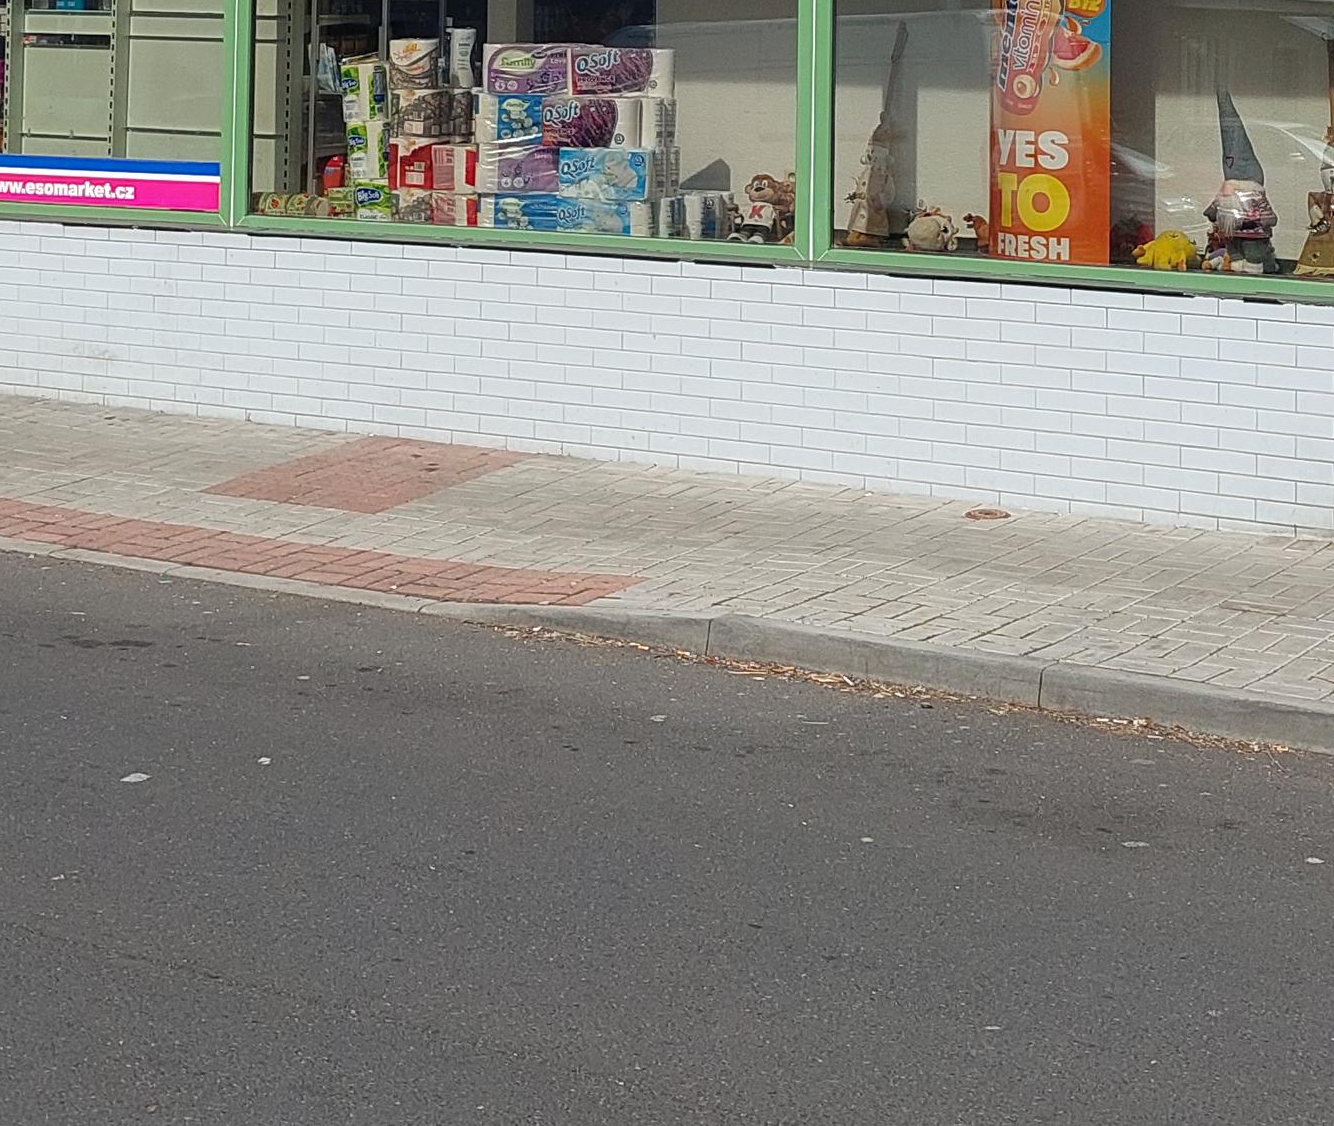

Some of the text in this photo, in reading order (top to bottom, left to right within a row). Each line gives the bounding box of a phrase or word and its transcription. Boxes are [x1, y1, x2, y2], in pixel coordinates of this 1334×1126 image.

[998, 128, 1069, 170] YES
[998, 172, 1070, 232] TO
[998, 232, 1070, 260] FRESH
